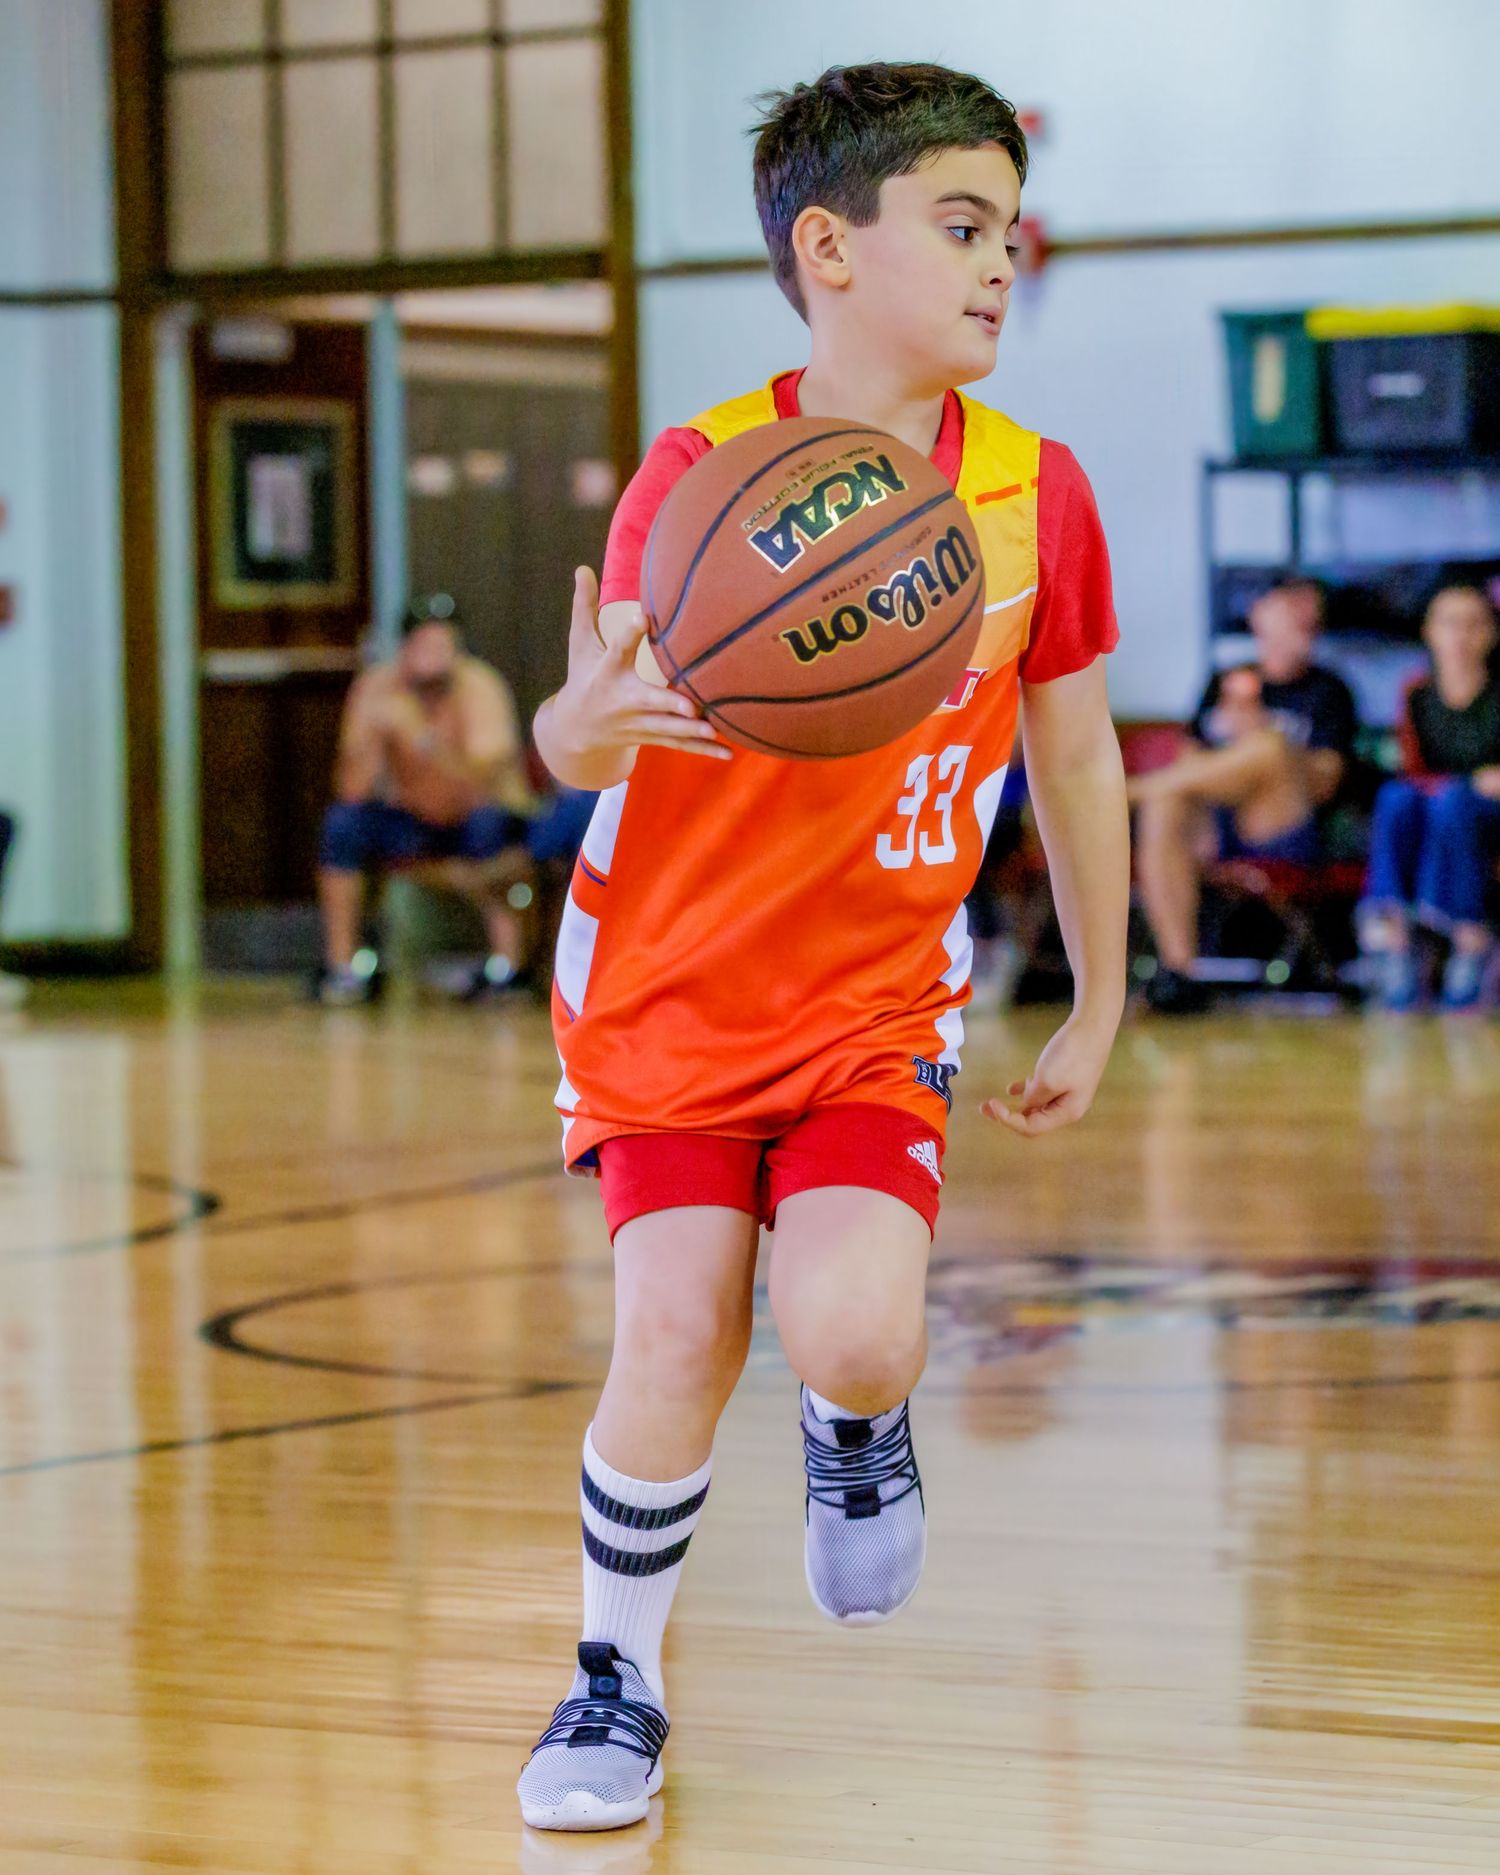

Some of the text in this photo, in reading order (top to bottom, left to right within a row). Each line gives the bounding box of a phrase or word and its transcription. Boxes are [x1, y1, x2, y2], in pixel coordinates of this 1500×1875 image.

[743, 482, 799, 531] EDITION
[748, 454, 907, 573] NCAA
[801, 459, 837, 484] FOUR
[779, 525, 976, 664] Wilson
[822, 568, 878, 602] LEATHER
[875, 745, 973, 869] 33
